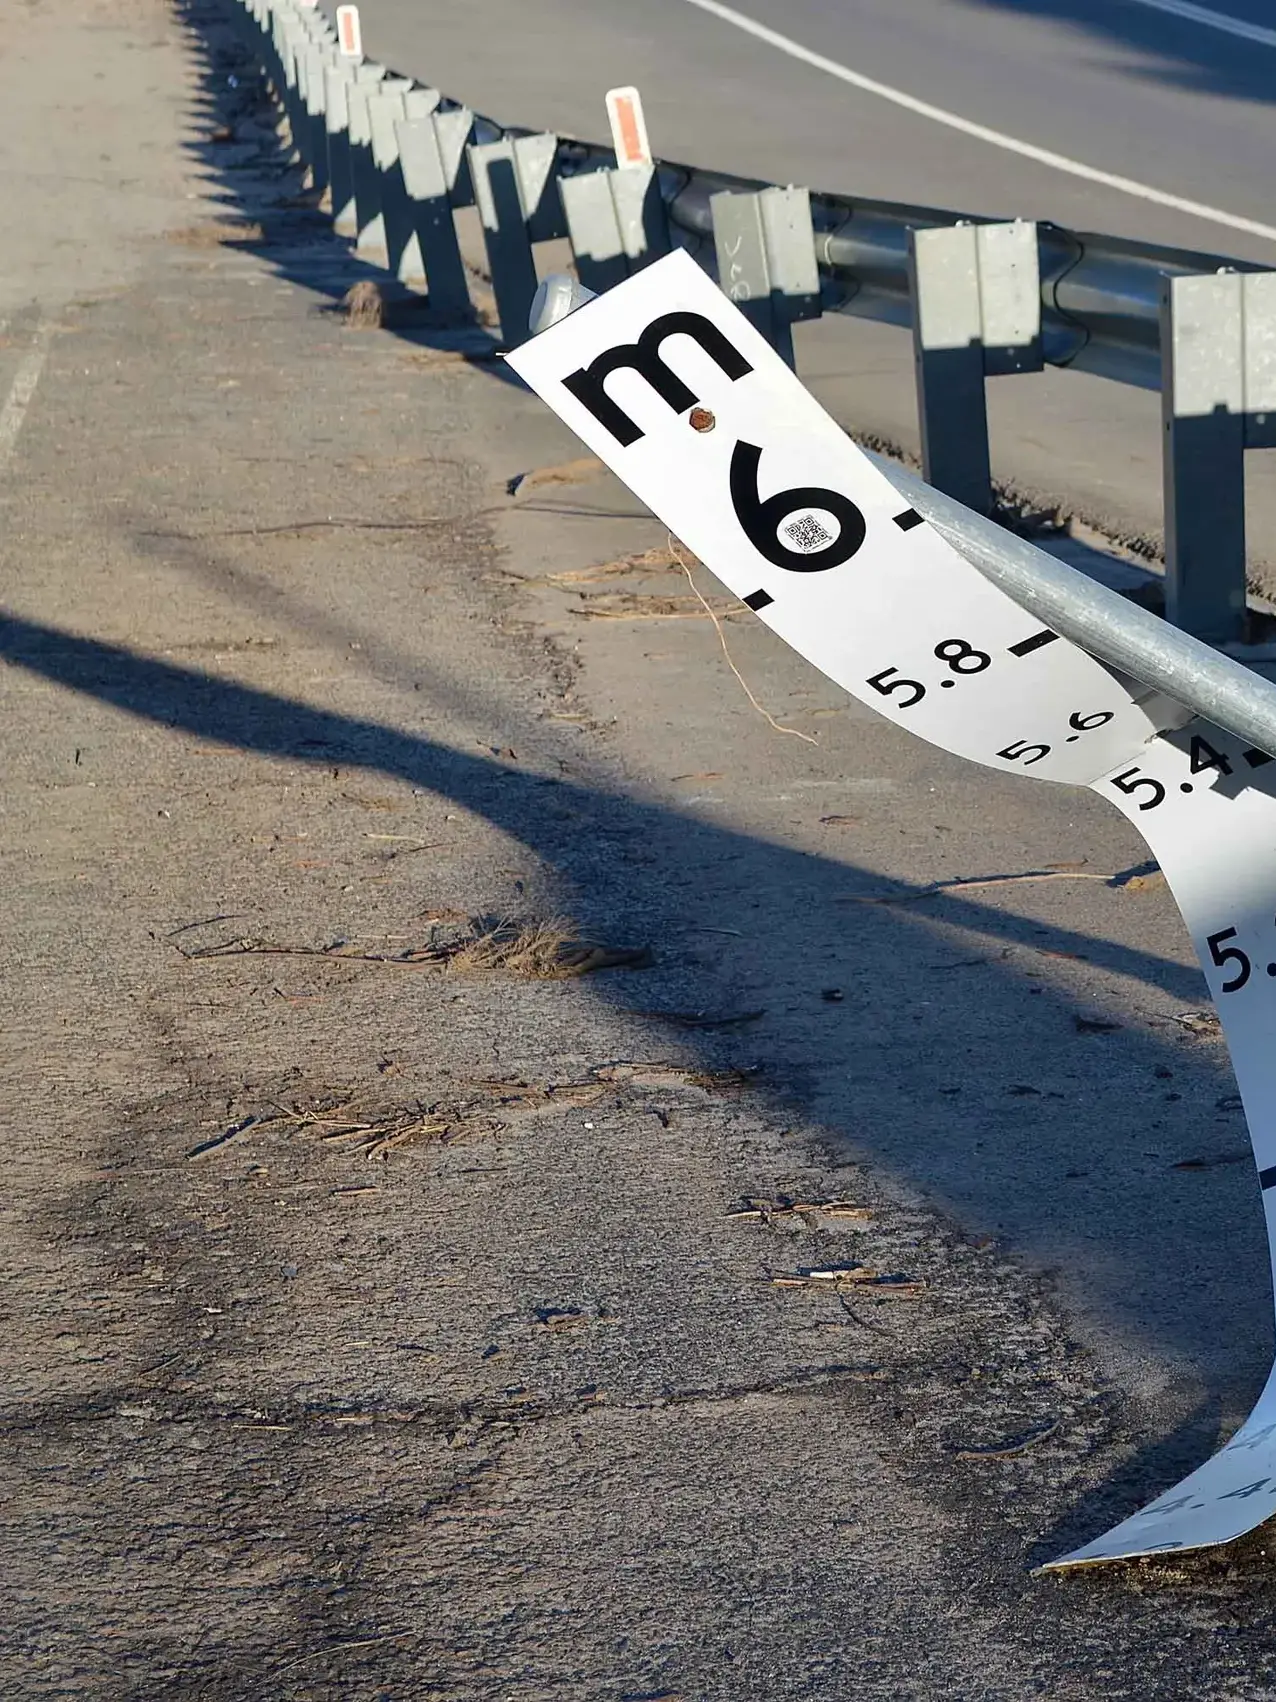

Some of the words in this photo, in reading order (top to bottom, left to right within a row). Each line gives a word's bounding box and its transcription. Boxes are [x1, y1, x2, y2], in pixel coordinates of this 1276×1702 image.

[560, 311, 755, 448] m
[729, 439, 867, 573] 6
[865, 638, 992, 709] 5.8
[994, 711, 1115, 766] 5.6
[1110, 735, 1233, 811] 5.4
